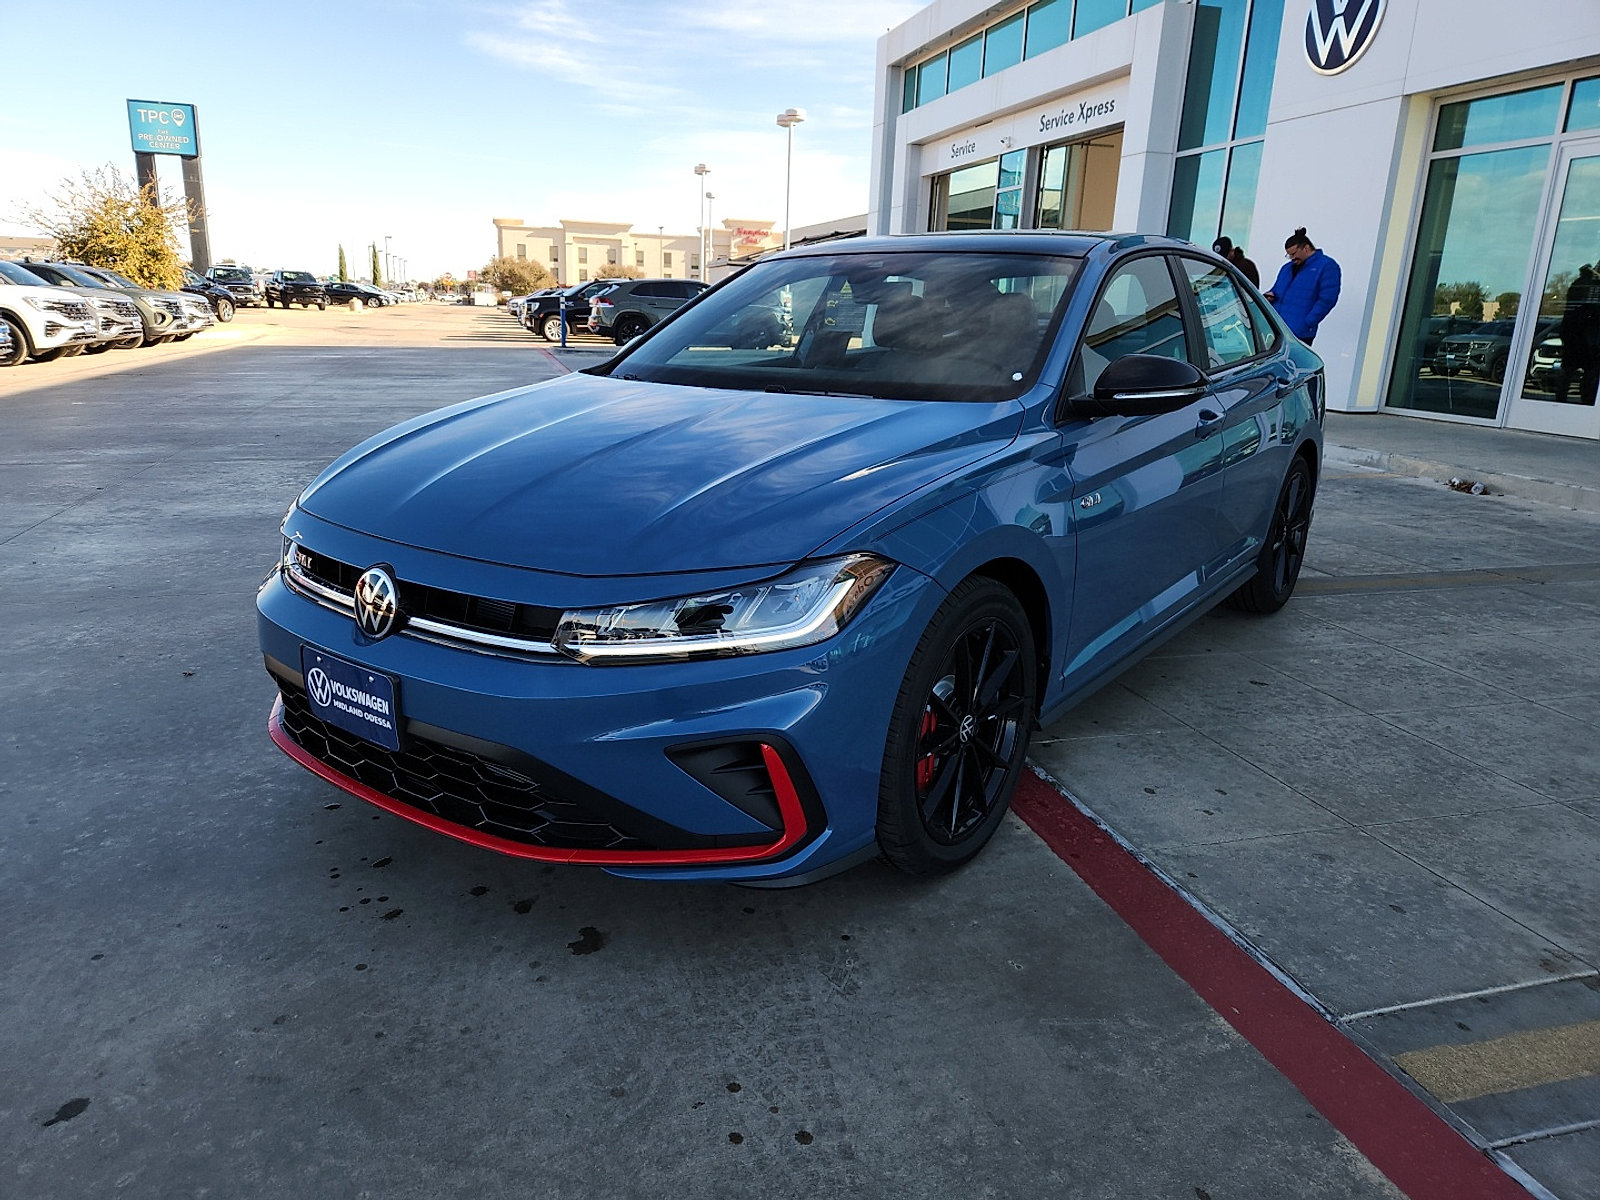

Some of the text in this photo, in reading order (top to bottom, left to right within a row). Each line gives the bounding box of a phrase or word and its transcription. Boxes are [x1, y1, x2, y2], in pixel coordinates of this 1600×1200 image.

[137, 108, 169, 125] TPC
[1039, 99, 1115, 133] Service Xpress
[149, 141, 180, 149] CENTER
[950, 140, 976, 159] Service
[330, 679, 389, 715] VOLKSWAGEN
[333, 699, 392, 730] MIDLAND ODESSA
